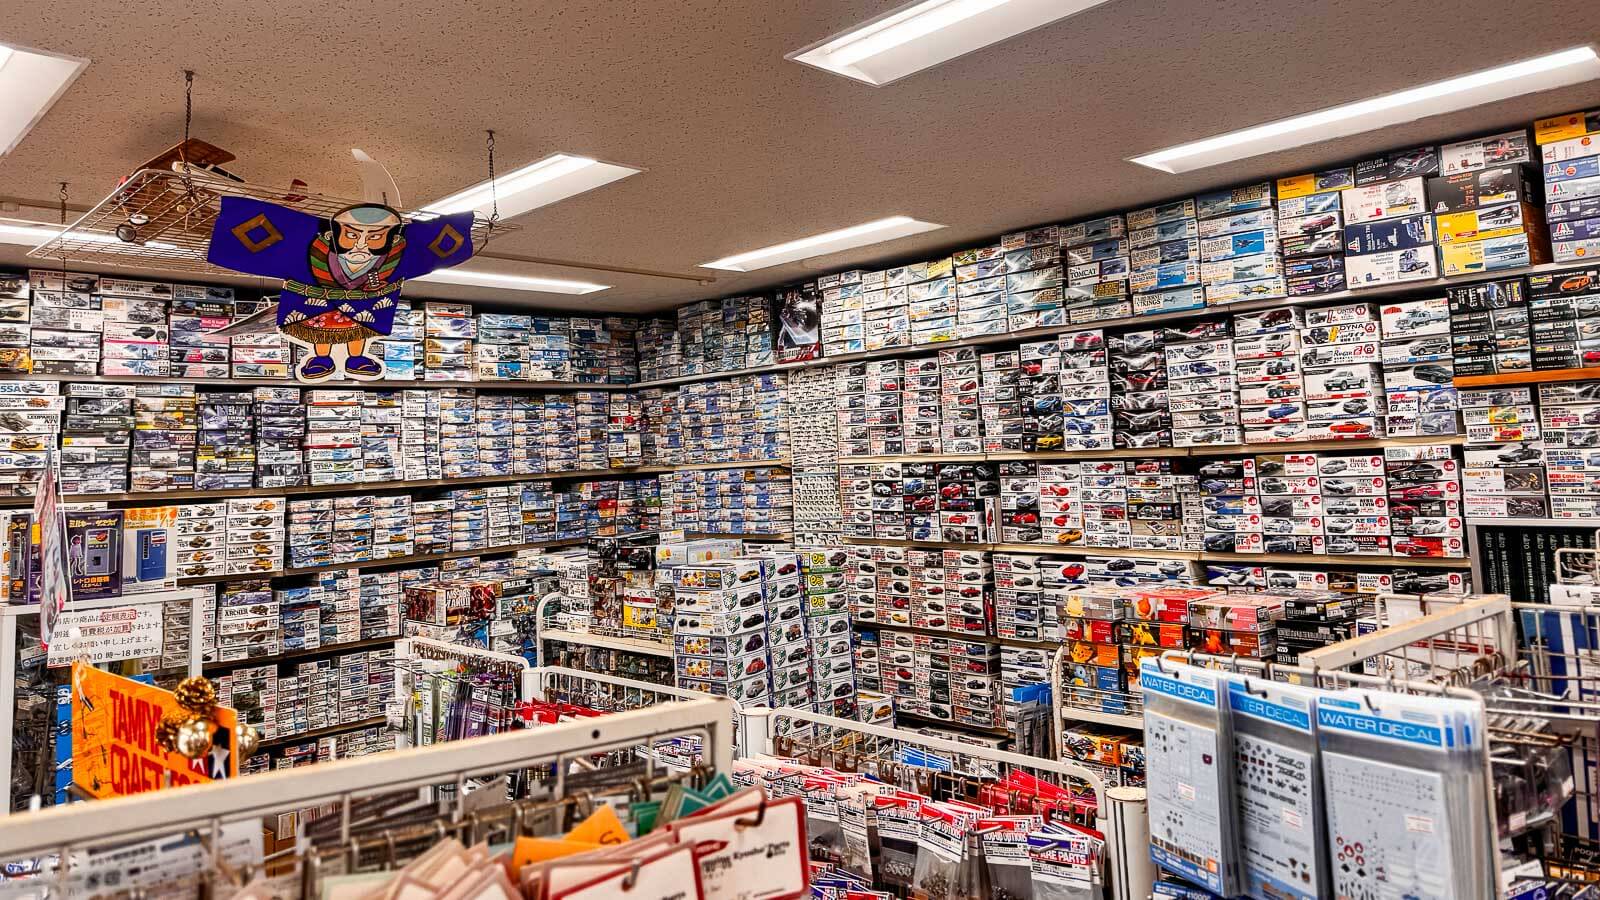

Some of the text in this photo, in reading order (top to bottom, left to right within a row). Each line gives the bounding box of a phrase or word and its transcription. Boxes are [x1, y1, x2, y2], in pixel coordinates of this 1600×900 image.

[1069, 267, 1096, 279] TOMCAT
[1136, 299, 1161, 307] VIKINGS
[1340, 323, 1364, 331] DYNA
[1143, 674, 1214, 704] WATER DECAL
[110, 689, 169, 760] TAMIY
[1265, 705, 1308, 728] DECAL
[1320, 711, 1440, 744] WATER DECAL
[110, 743, 165, 796] CRAFT
[1058, 851, 1087, 865] PARTS
